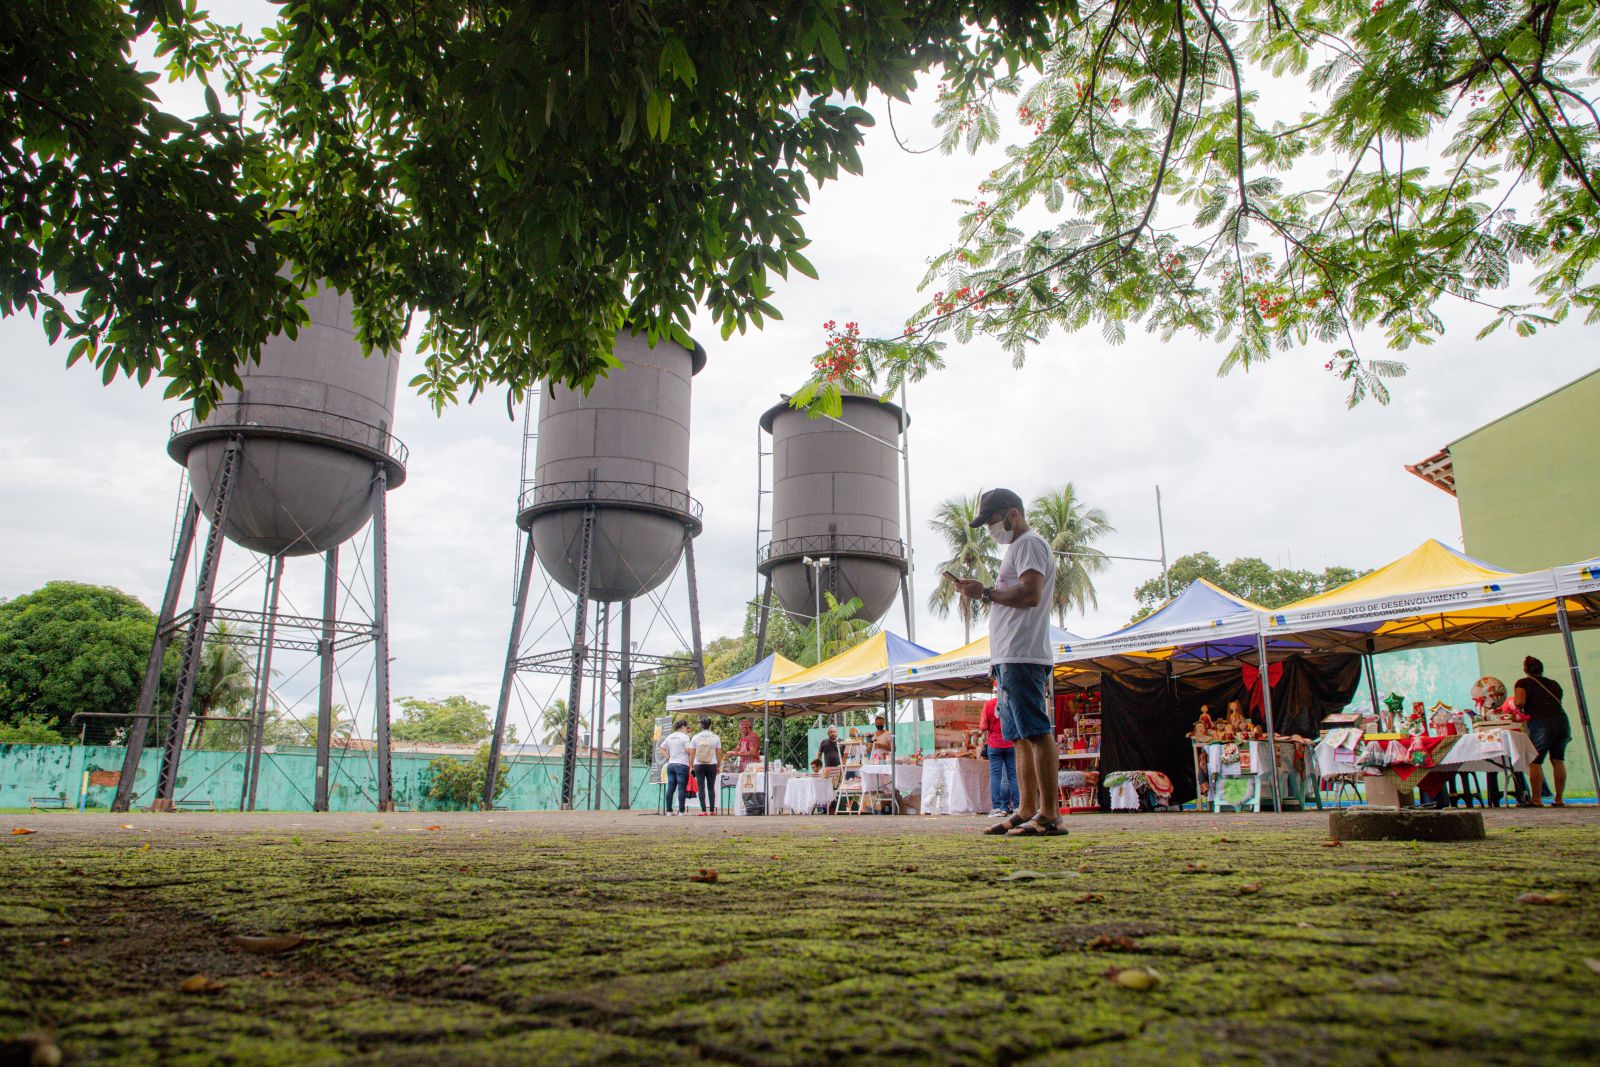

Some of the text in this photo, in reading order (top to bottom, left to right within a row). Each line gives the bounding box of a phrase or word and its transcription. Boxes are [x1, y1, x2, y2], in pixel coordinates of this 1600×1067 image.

[1301, 591, 1468, 620] DEPARTAMENTO DE DESENVOLVIMENTO
[1082, 637, 1128, 648] DEPARTAMENTO
[1138, 626, 1200, 640] DESENVOLVIMENTO
